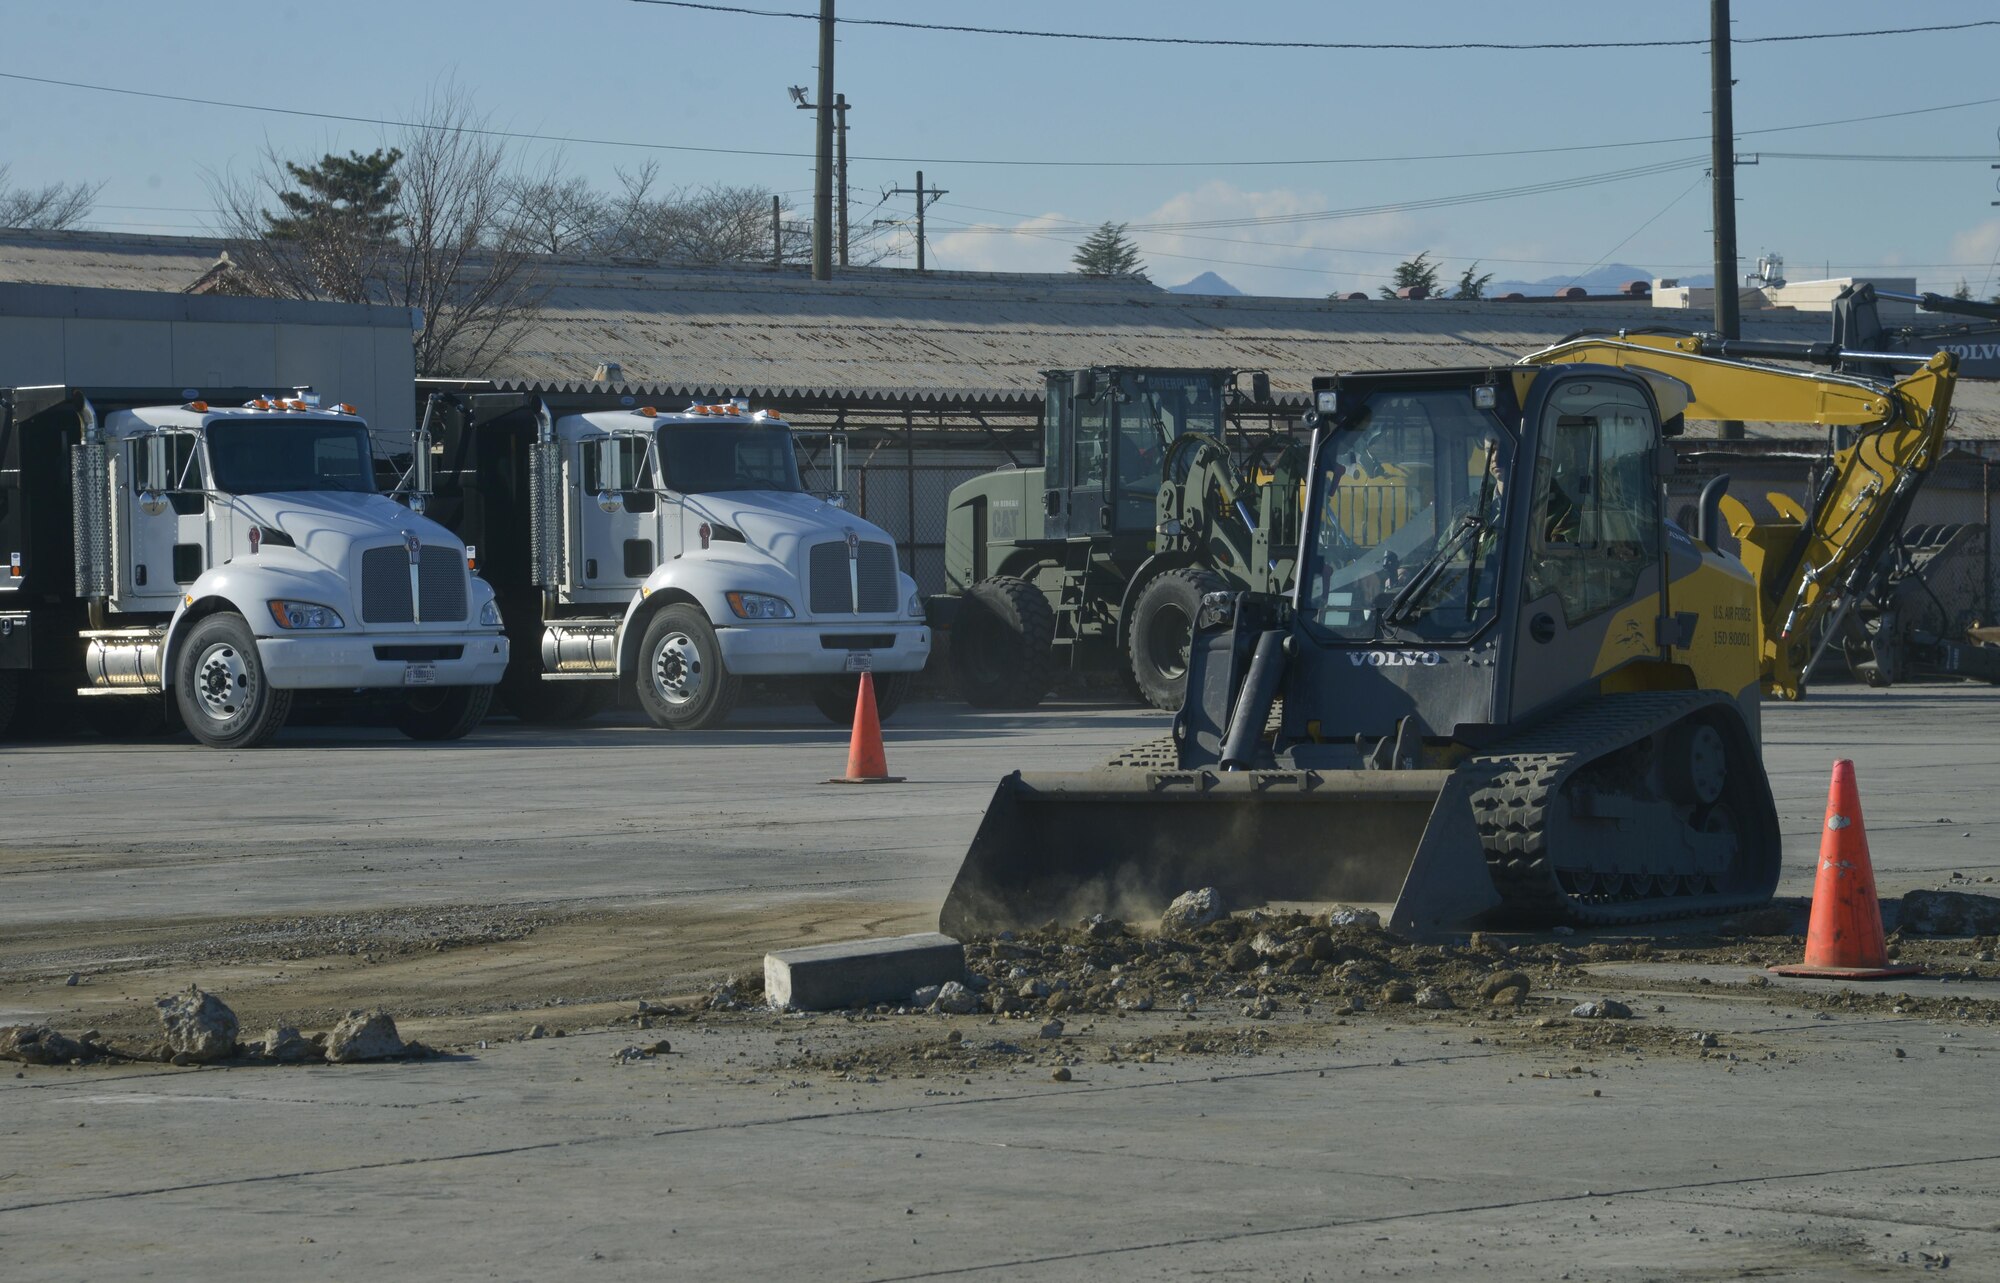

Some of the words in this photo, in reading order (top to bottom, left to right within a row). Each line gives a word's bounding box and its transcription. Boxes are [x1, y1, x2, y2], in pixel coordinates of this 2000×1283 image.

[1936, 344, 2000, 360] VOLV
[1148, 377, 1208, 390] CATERPILLAR
[993, 510, 1020, 537] CAT
[1346, 651, 1440, 667] VOLVO
